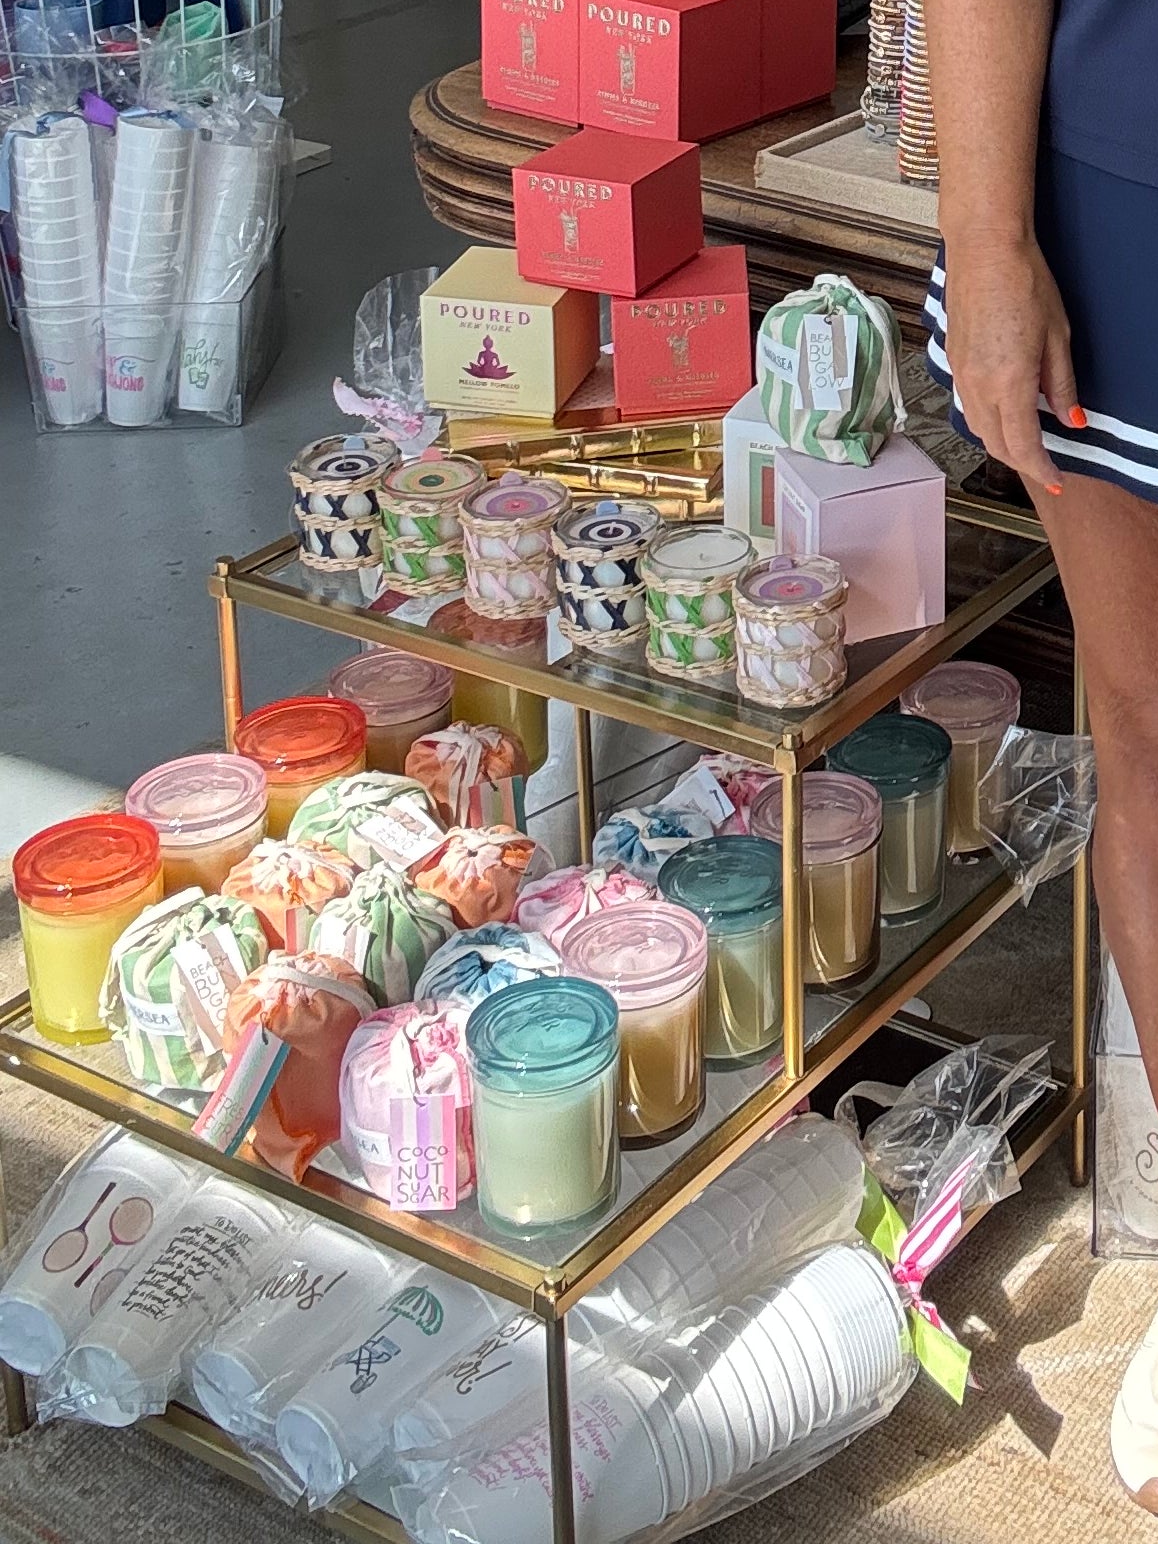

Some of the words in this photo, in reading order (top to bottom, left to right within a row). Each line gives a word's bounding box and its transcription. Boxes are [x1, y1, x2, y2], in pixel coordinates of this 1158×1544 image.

[587, 3, 671, 37] POURED
[528, 175, 613, 201] POURED
[440, 302, 531, 325] POURED
[631, 299, 727, 319] POURED
[459, 321, 481, 329] NEW
[485, 323, 512, 333] YORK
[810, 333, 832, 344] BEA
[809, 345, 833, 363] BU
[397, 1145, 449, 1162] COCO
[398, 1162, 444, 1185] NUT
[396, 1181, 450, 1204] SUGAR
